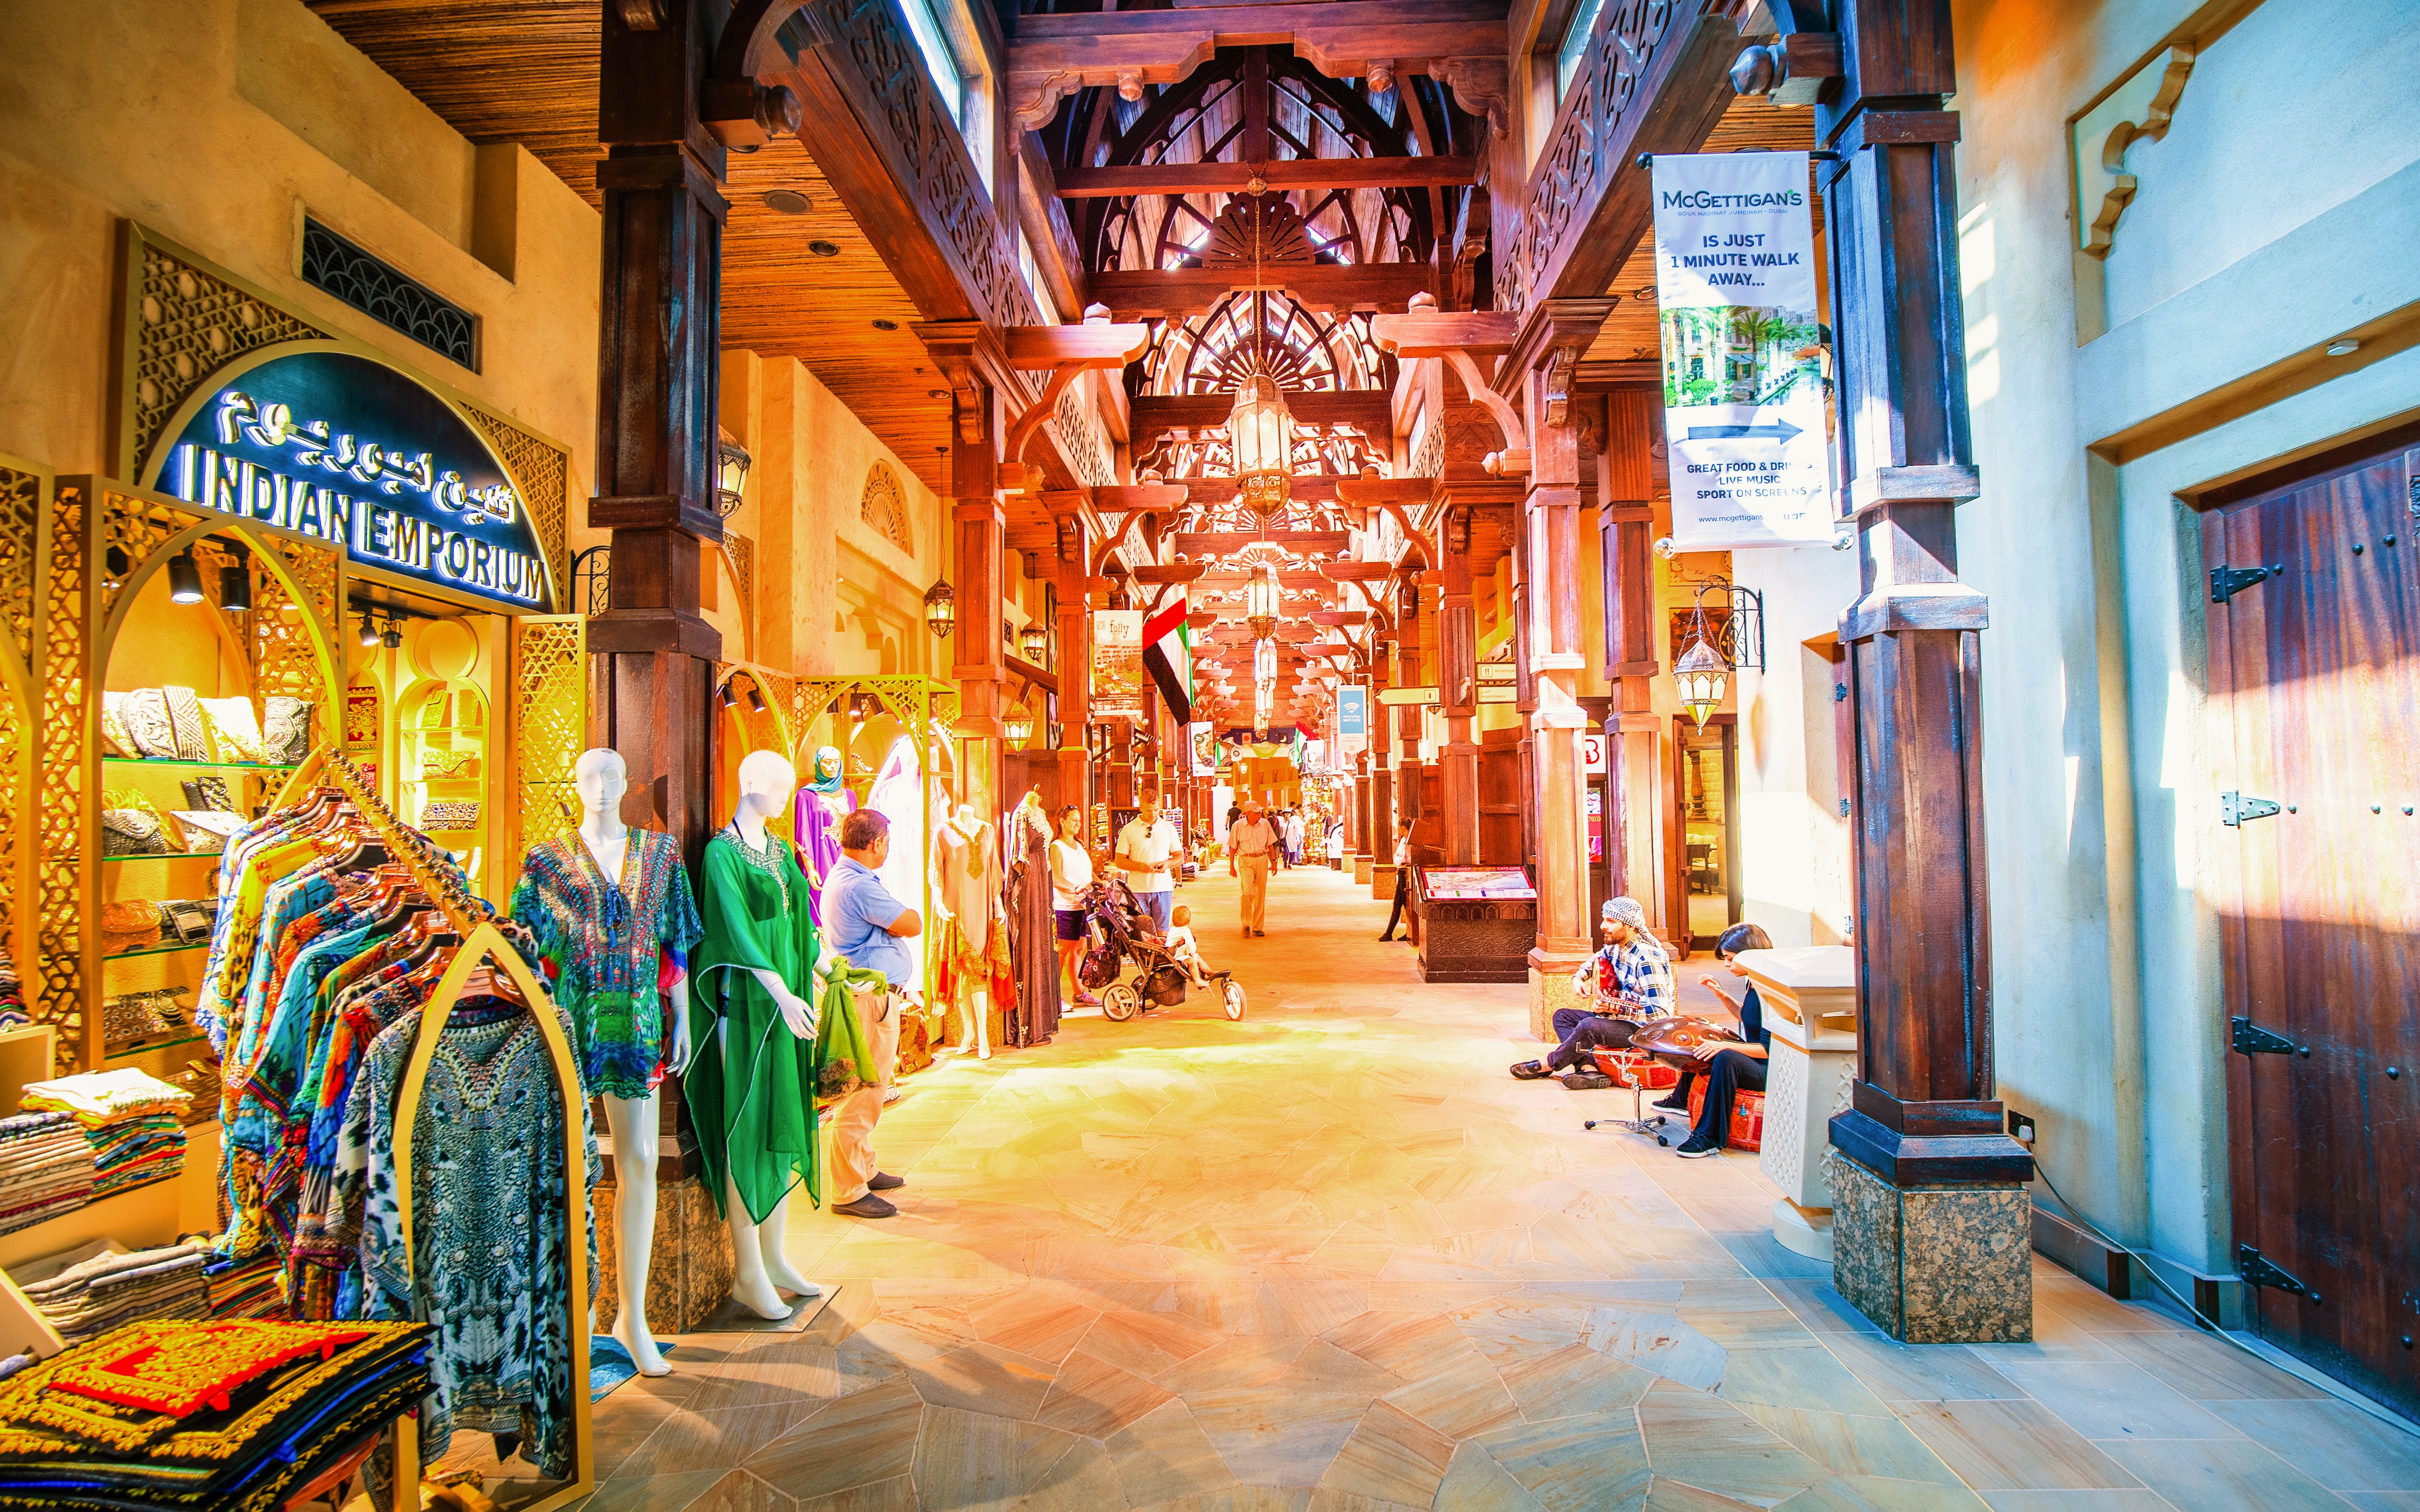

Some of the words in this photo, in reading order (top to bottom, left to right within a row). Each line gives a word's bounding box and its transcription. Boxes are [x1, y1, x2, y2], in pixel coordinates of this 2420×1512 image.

[1703, 235, 1719, 247] IS
[1723, 234, 1765, 247] JUST
[1671, 256, 1679, 268] 1
[1683, 253, 1747, 268] MINUTE
[1751, 252, 1800, 266] WALK
[1708, 272, 1765, 286] AWAY...
[1687, 463, 1723, 474] GREAT
[1726, 463, 1756, 472] FOOD
[1759, 462, 1768, 471] &
[1719, 476, 1743, 485] LIVE
[1747, 475, 1780, 484] MUSIC
[1697, 490, 1733, 499] SPORT
[1736, 489, 1752, 497] ON
[1755, 487, 1806, 497] SCREENS
[178, 443, 352, 545] INDIAN
[354, 500, 544, 603] EMPORIUM
[1110, 620, 1129, 639] folly
